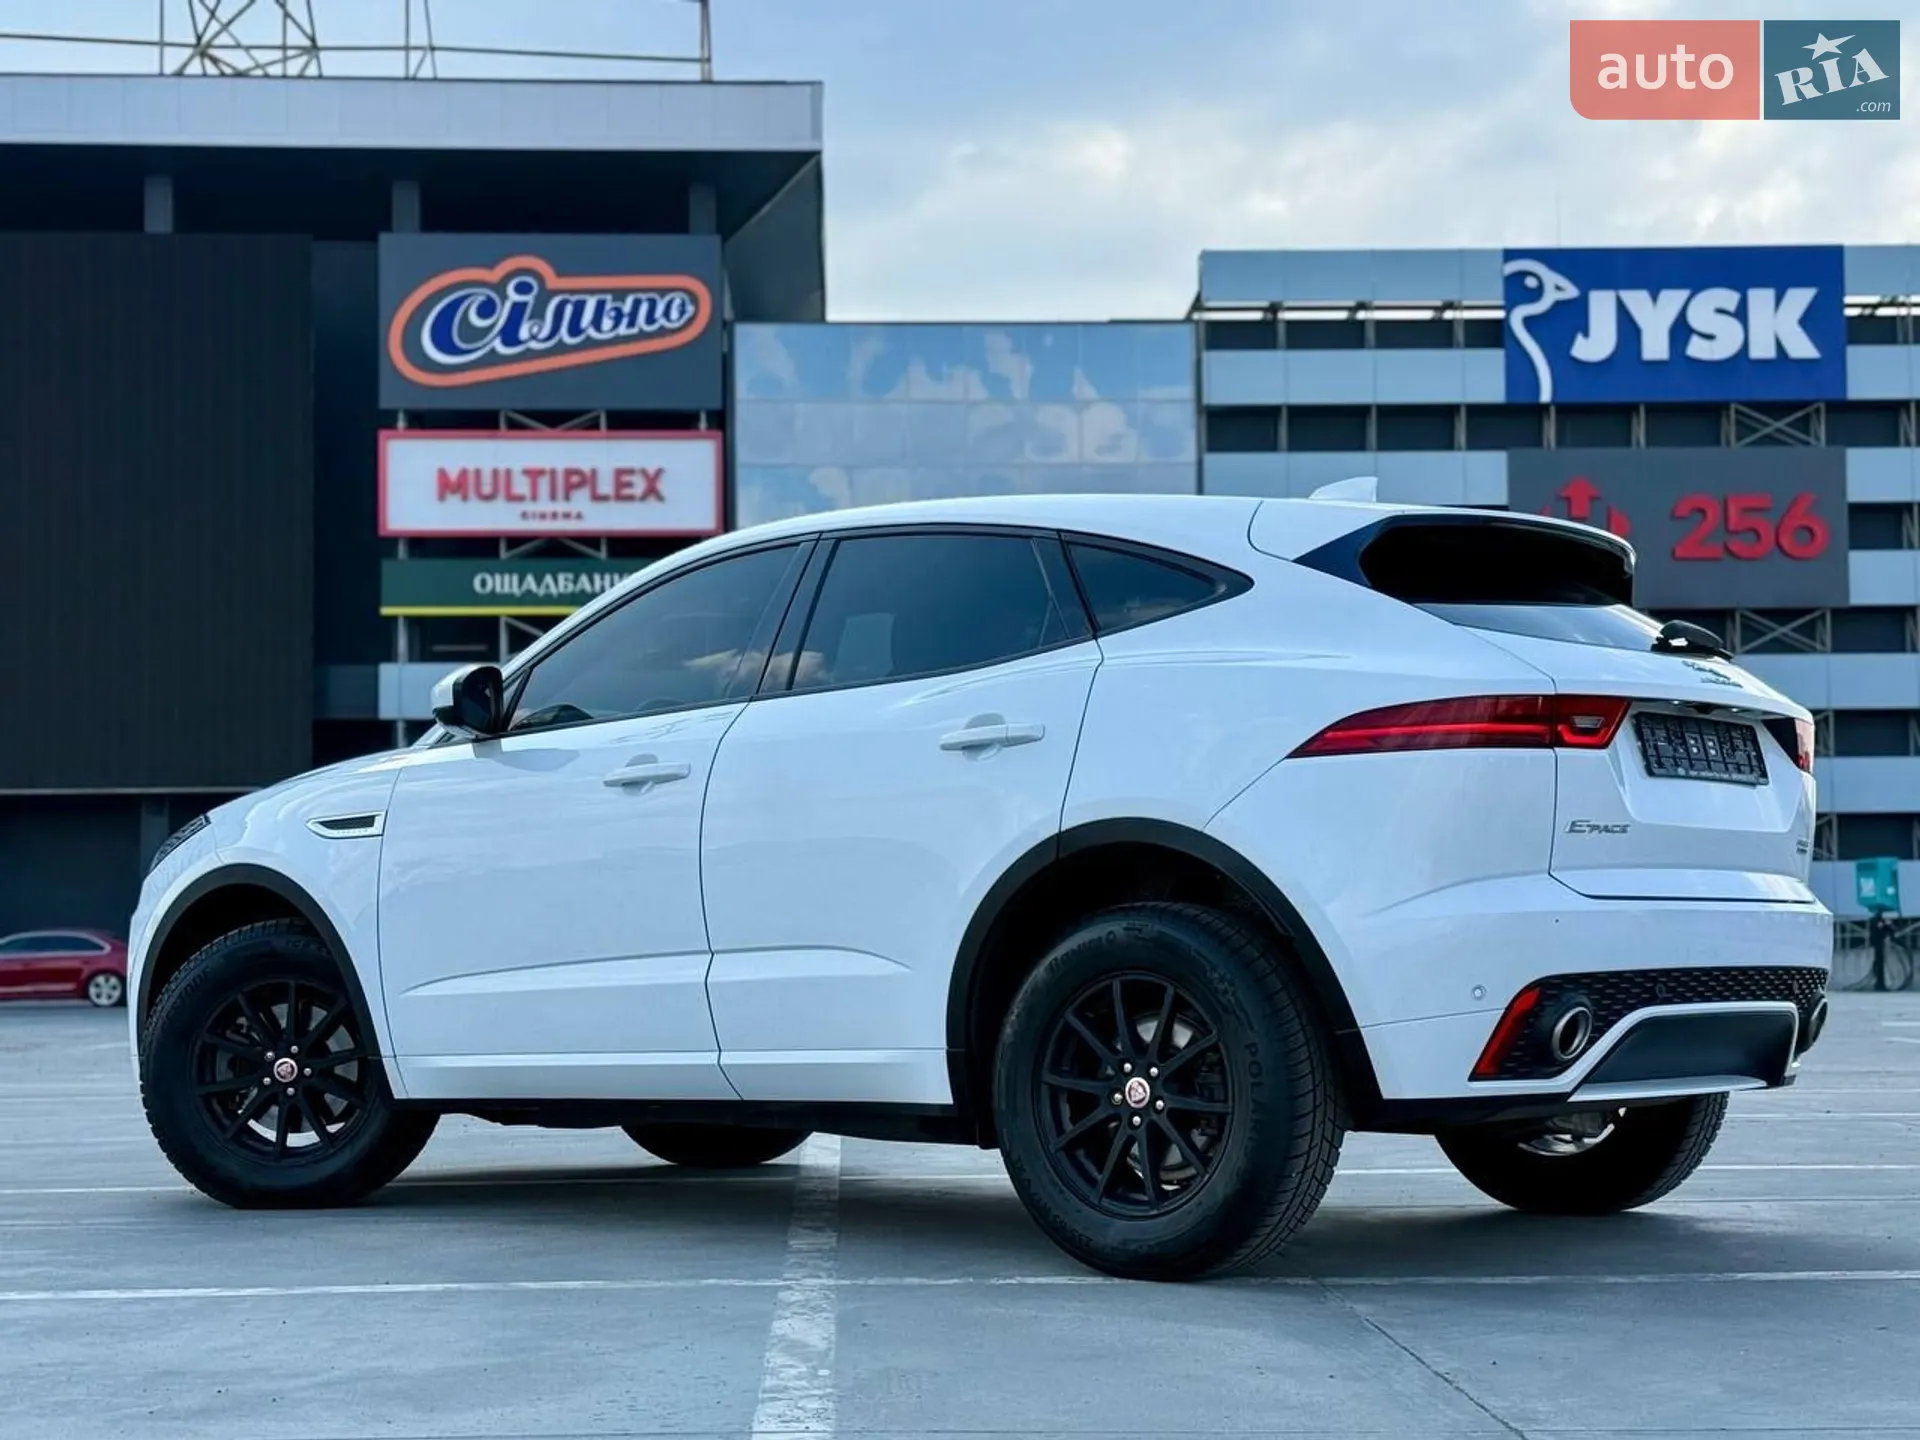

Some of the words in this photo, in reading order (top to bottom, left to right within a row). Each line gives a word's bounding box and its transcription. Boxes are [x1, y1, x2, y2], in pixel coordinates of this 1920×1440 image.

[421, 275, 695, 364] Сільпо
[1570, 286, 1821, 362] JYSK
[436, 468, 665, 502] MULTIPLEX
[520, 510, 585, 521] CINEMA
[1673, 491, 1828, 559] 256
